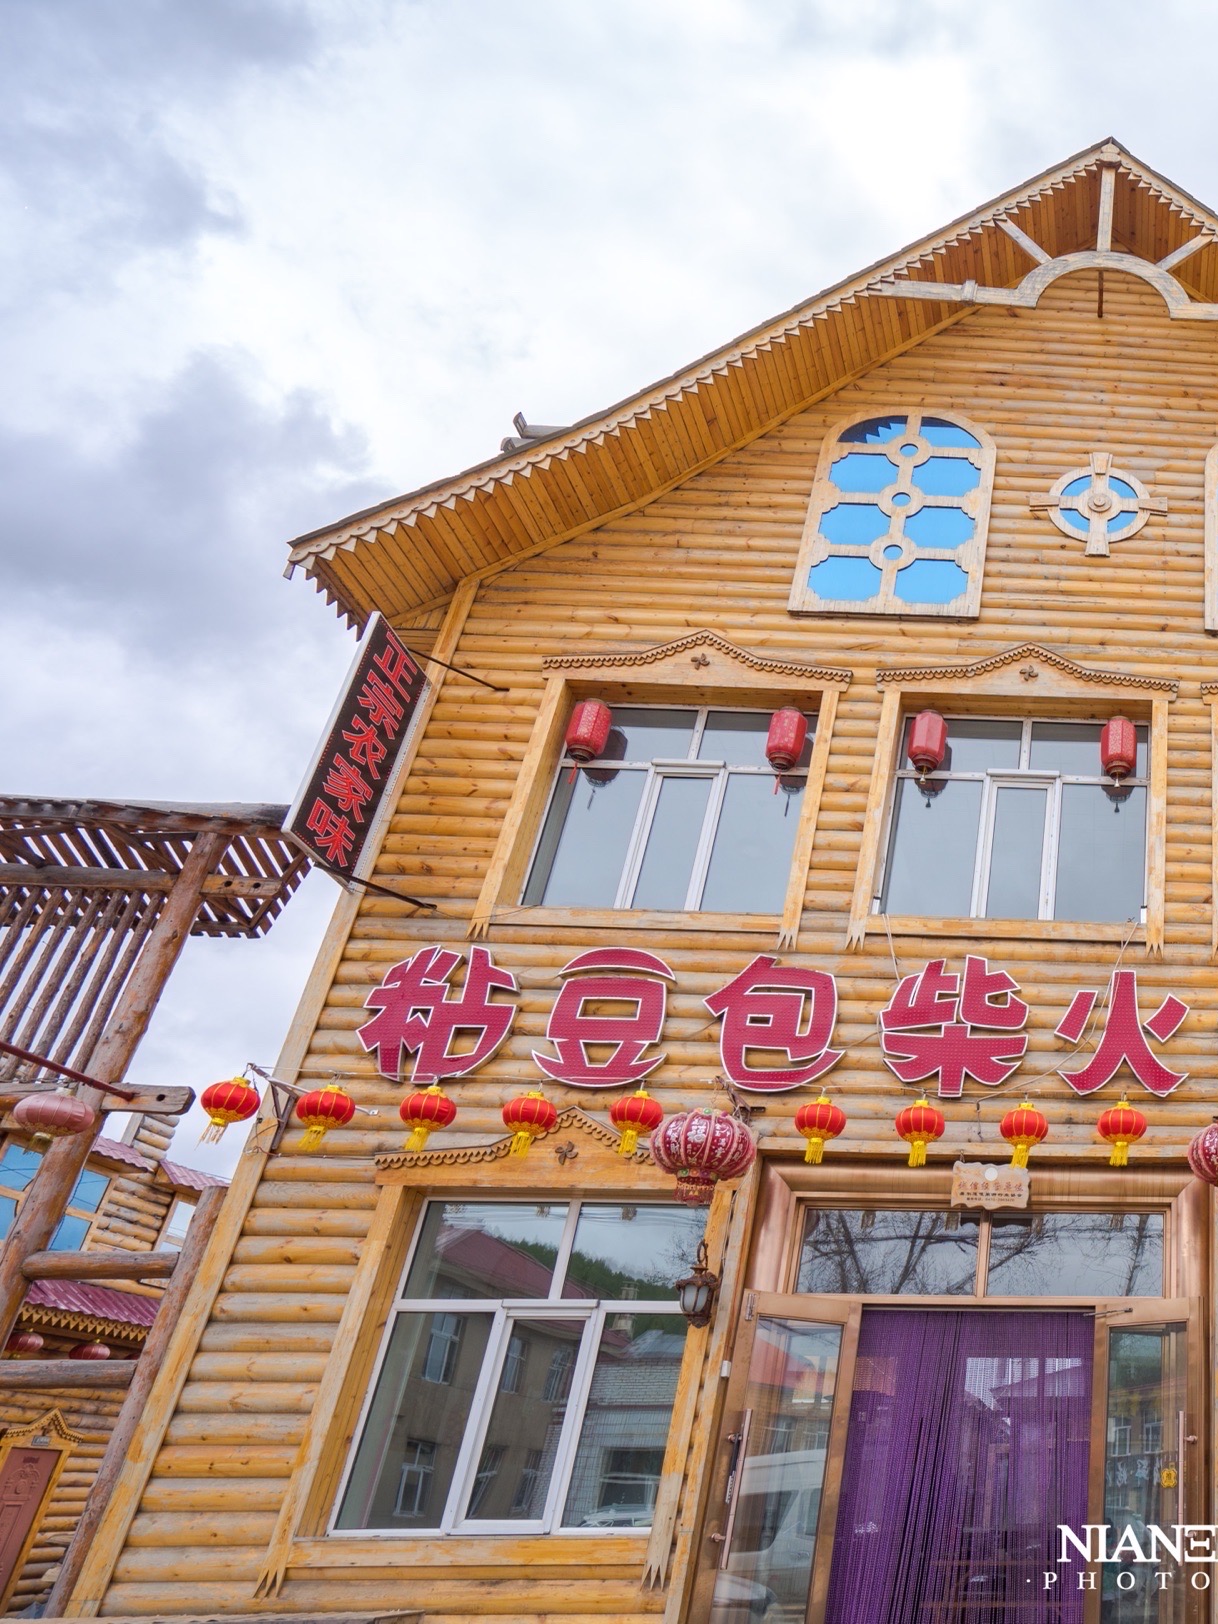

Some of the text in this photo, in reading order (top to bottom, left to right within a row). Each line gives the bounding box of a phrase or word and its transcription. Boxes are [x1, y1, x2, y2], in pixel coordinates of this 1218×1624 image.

[306, 631, 418, 868] 正宗农家味
